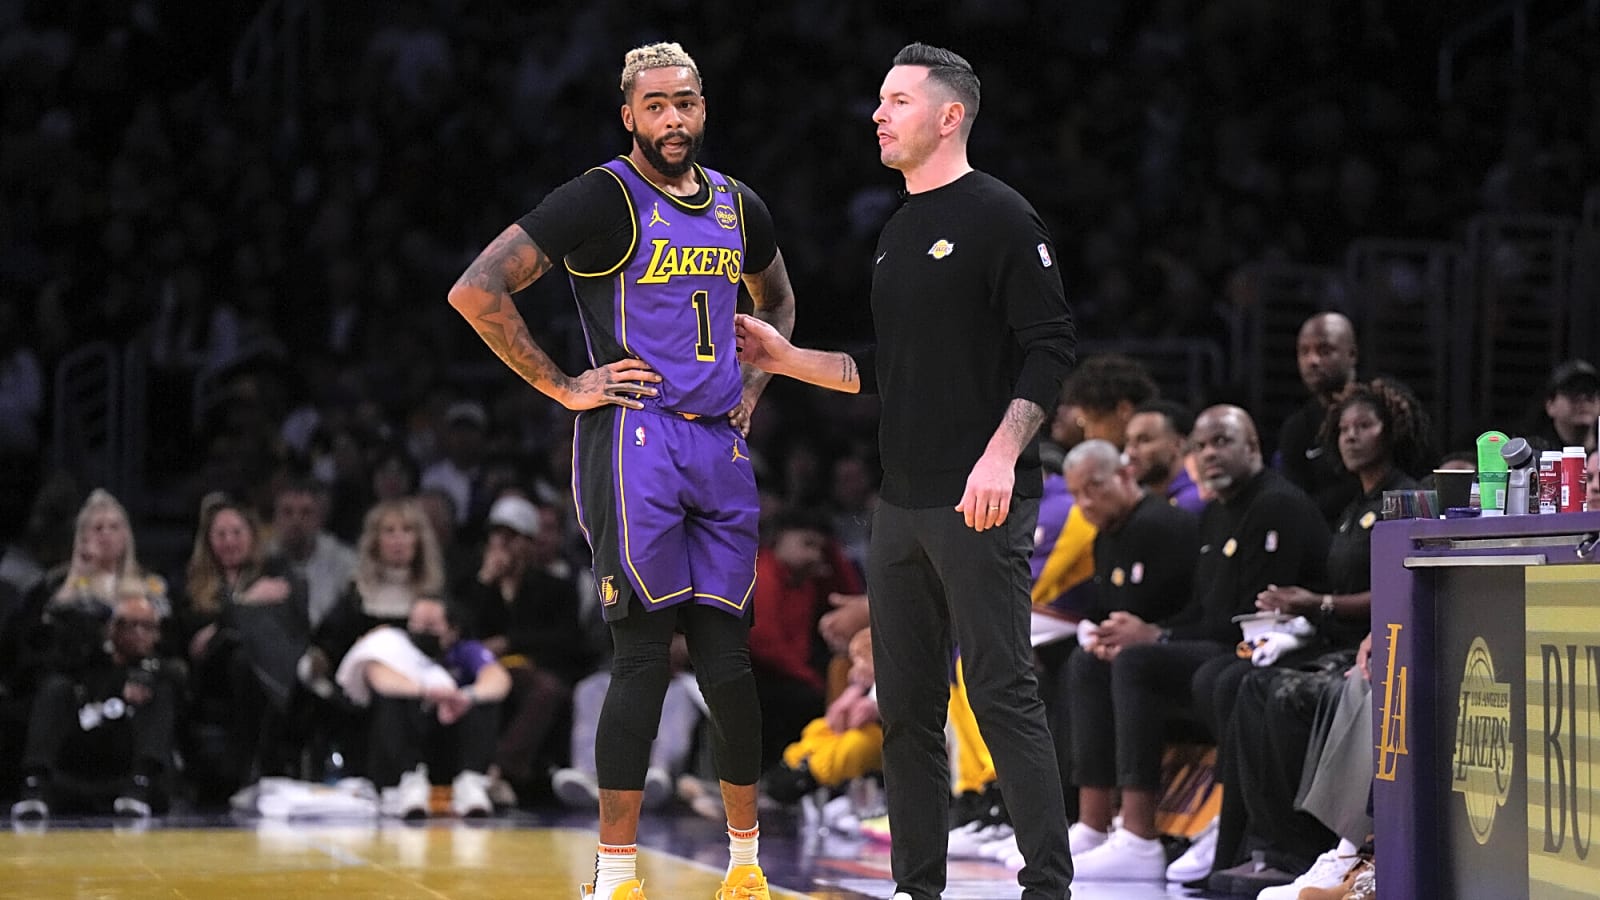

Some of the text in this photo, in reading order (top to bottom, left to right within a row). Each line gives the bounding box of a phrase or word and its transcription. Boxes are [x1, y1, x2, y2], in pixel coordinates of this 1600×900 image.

[637, 239, 742, 284] LAKERS
[692, 290, 716, 362] 1
[1376, 624, 1408, 781] LA
[1482, 691, 1508, 708] ANGELES
[1455, 691, 1508, 794] LAKERS
